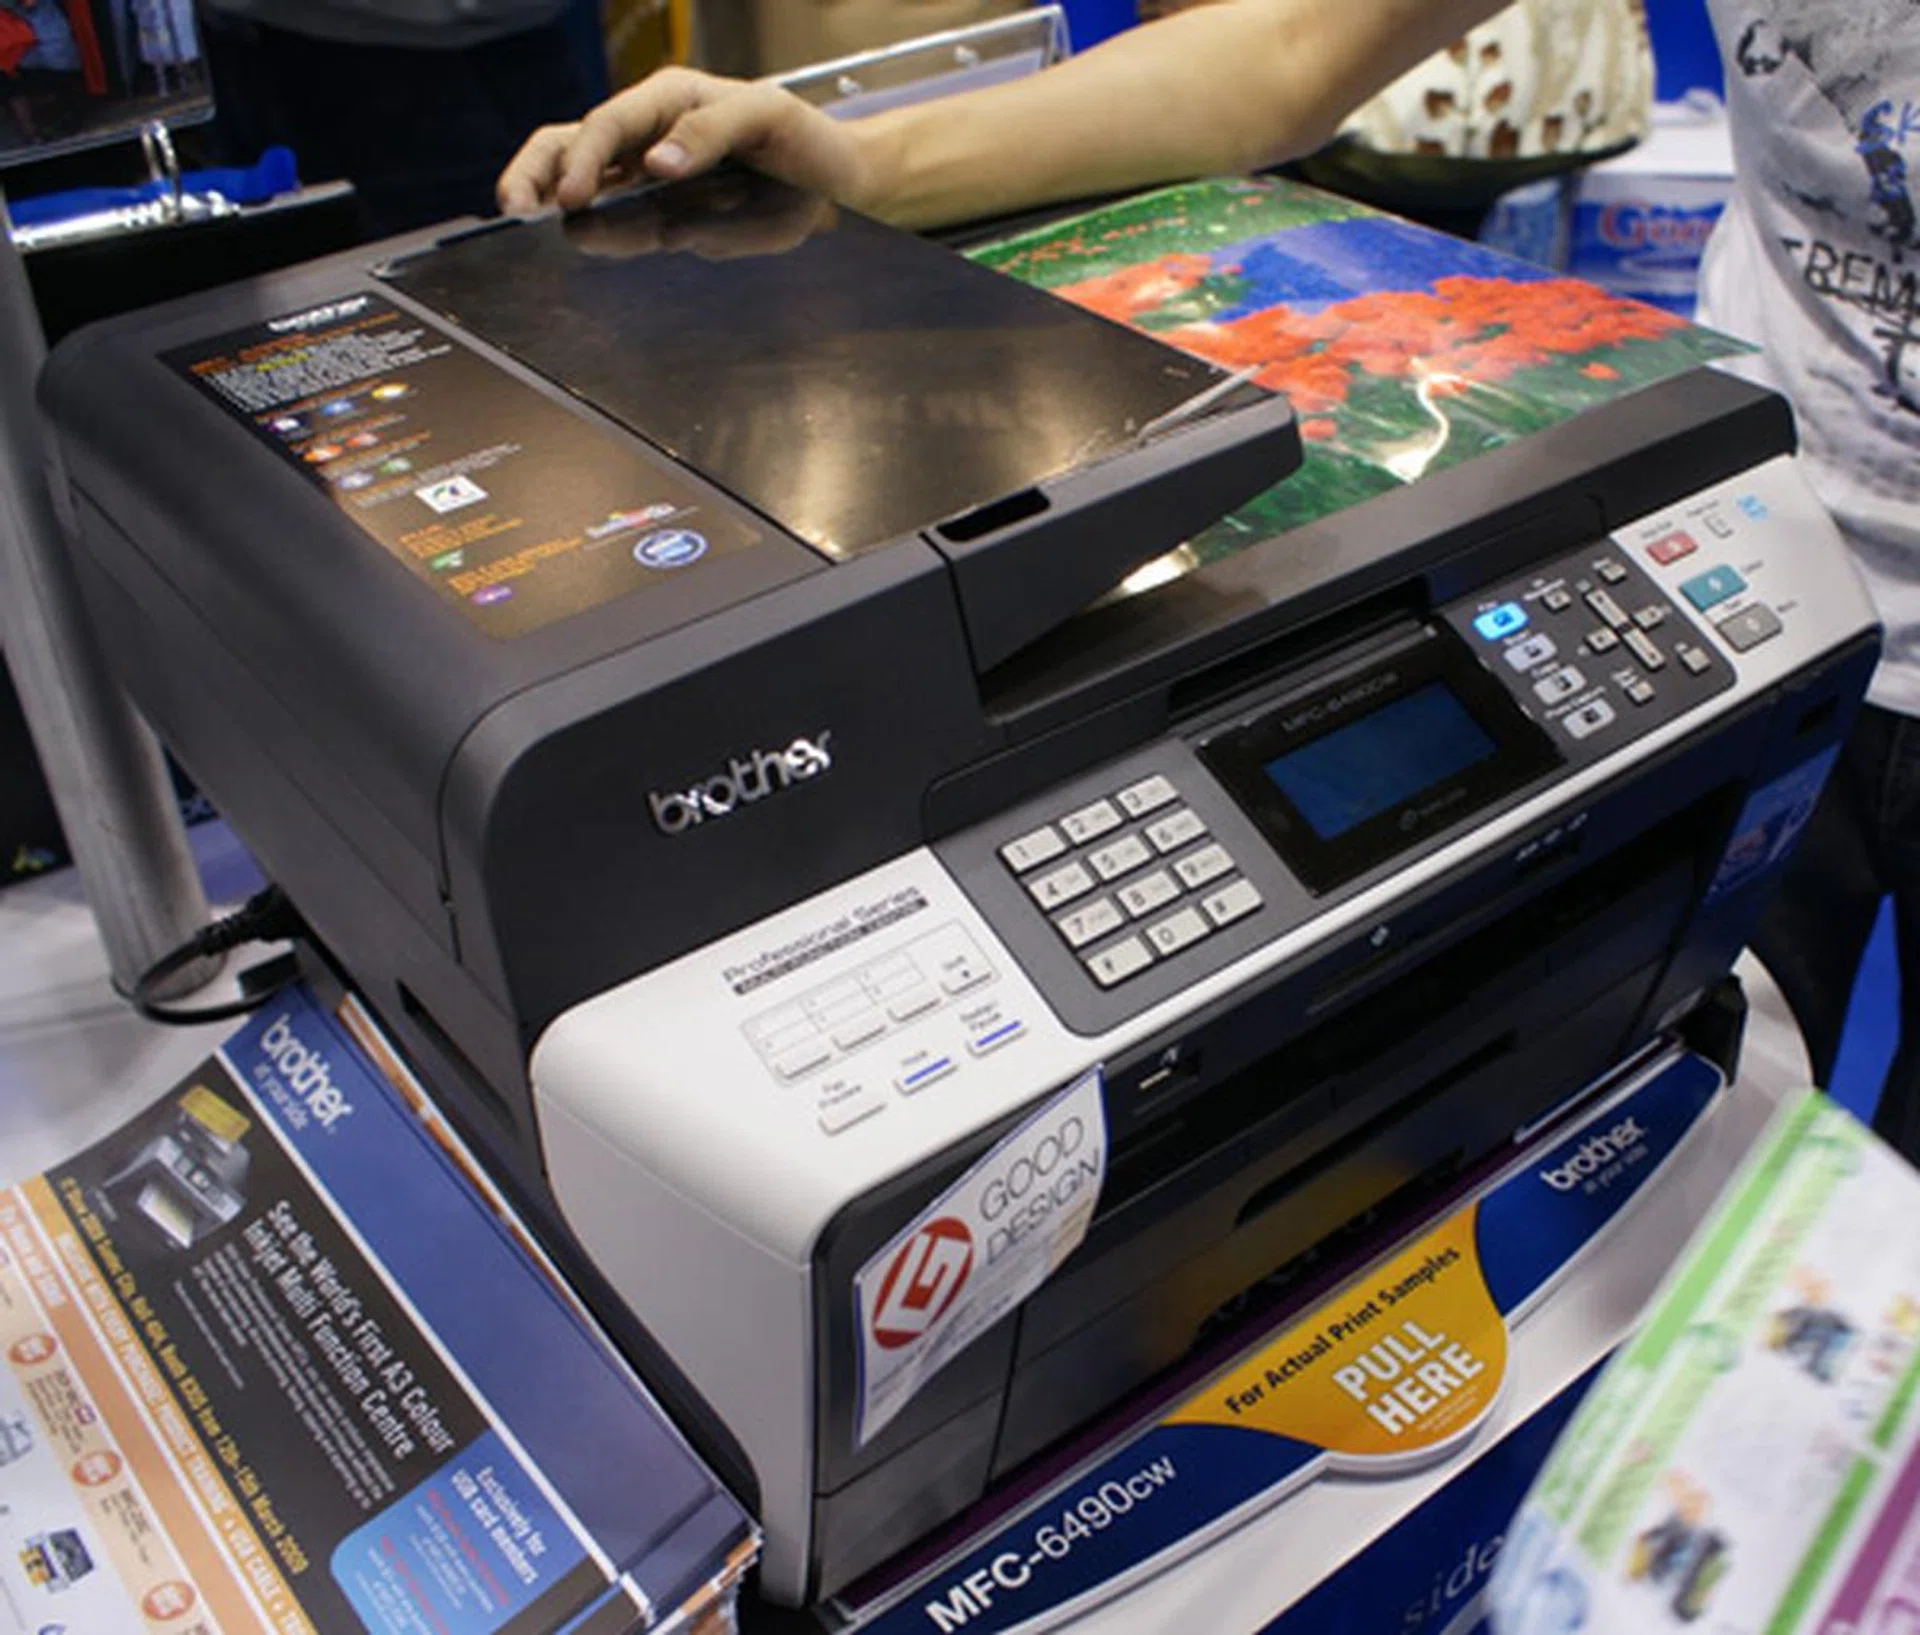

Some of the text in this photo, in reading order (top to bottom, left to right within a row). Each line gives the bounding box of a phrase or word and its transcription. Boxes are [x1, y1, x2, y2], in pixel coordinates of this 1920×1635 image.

[648, 729, 832, 834] brother
[722, 917, 850, 982] Professional
[852, 886, 920, 920] Series
[261, 1013, 353, 1127] brother
[980, 1115, 1084, 1223] GOOD
[1539, 1116, 1646, 1191] brother
[986, 1147, 1099, 1266] DESIGN
[243, 1218, 289, 1277] Inkjet
[275, 1266, 324, 1319] Multi
[307, 1312, 370, 1395] Function
[360, 1389, 415, 1460] Centre
[268, 1200, 455, 1454] See the World's First A3 Colour
[1225, 1247, 1460, 1414] For Actual Print Samples
[1332, 1320, 1446, 1402] PULL
[1366, 1341, 1484, 1434] HERE
[475, 1466, 531, 1539] Exclusively
[491, 1526, 539, 1585] members
